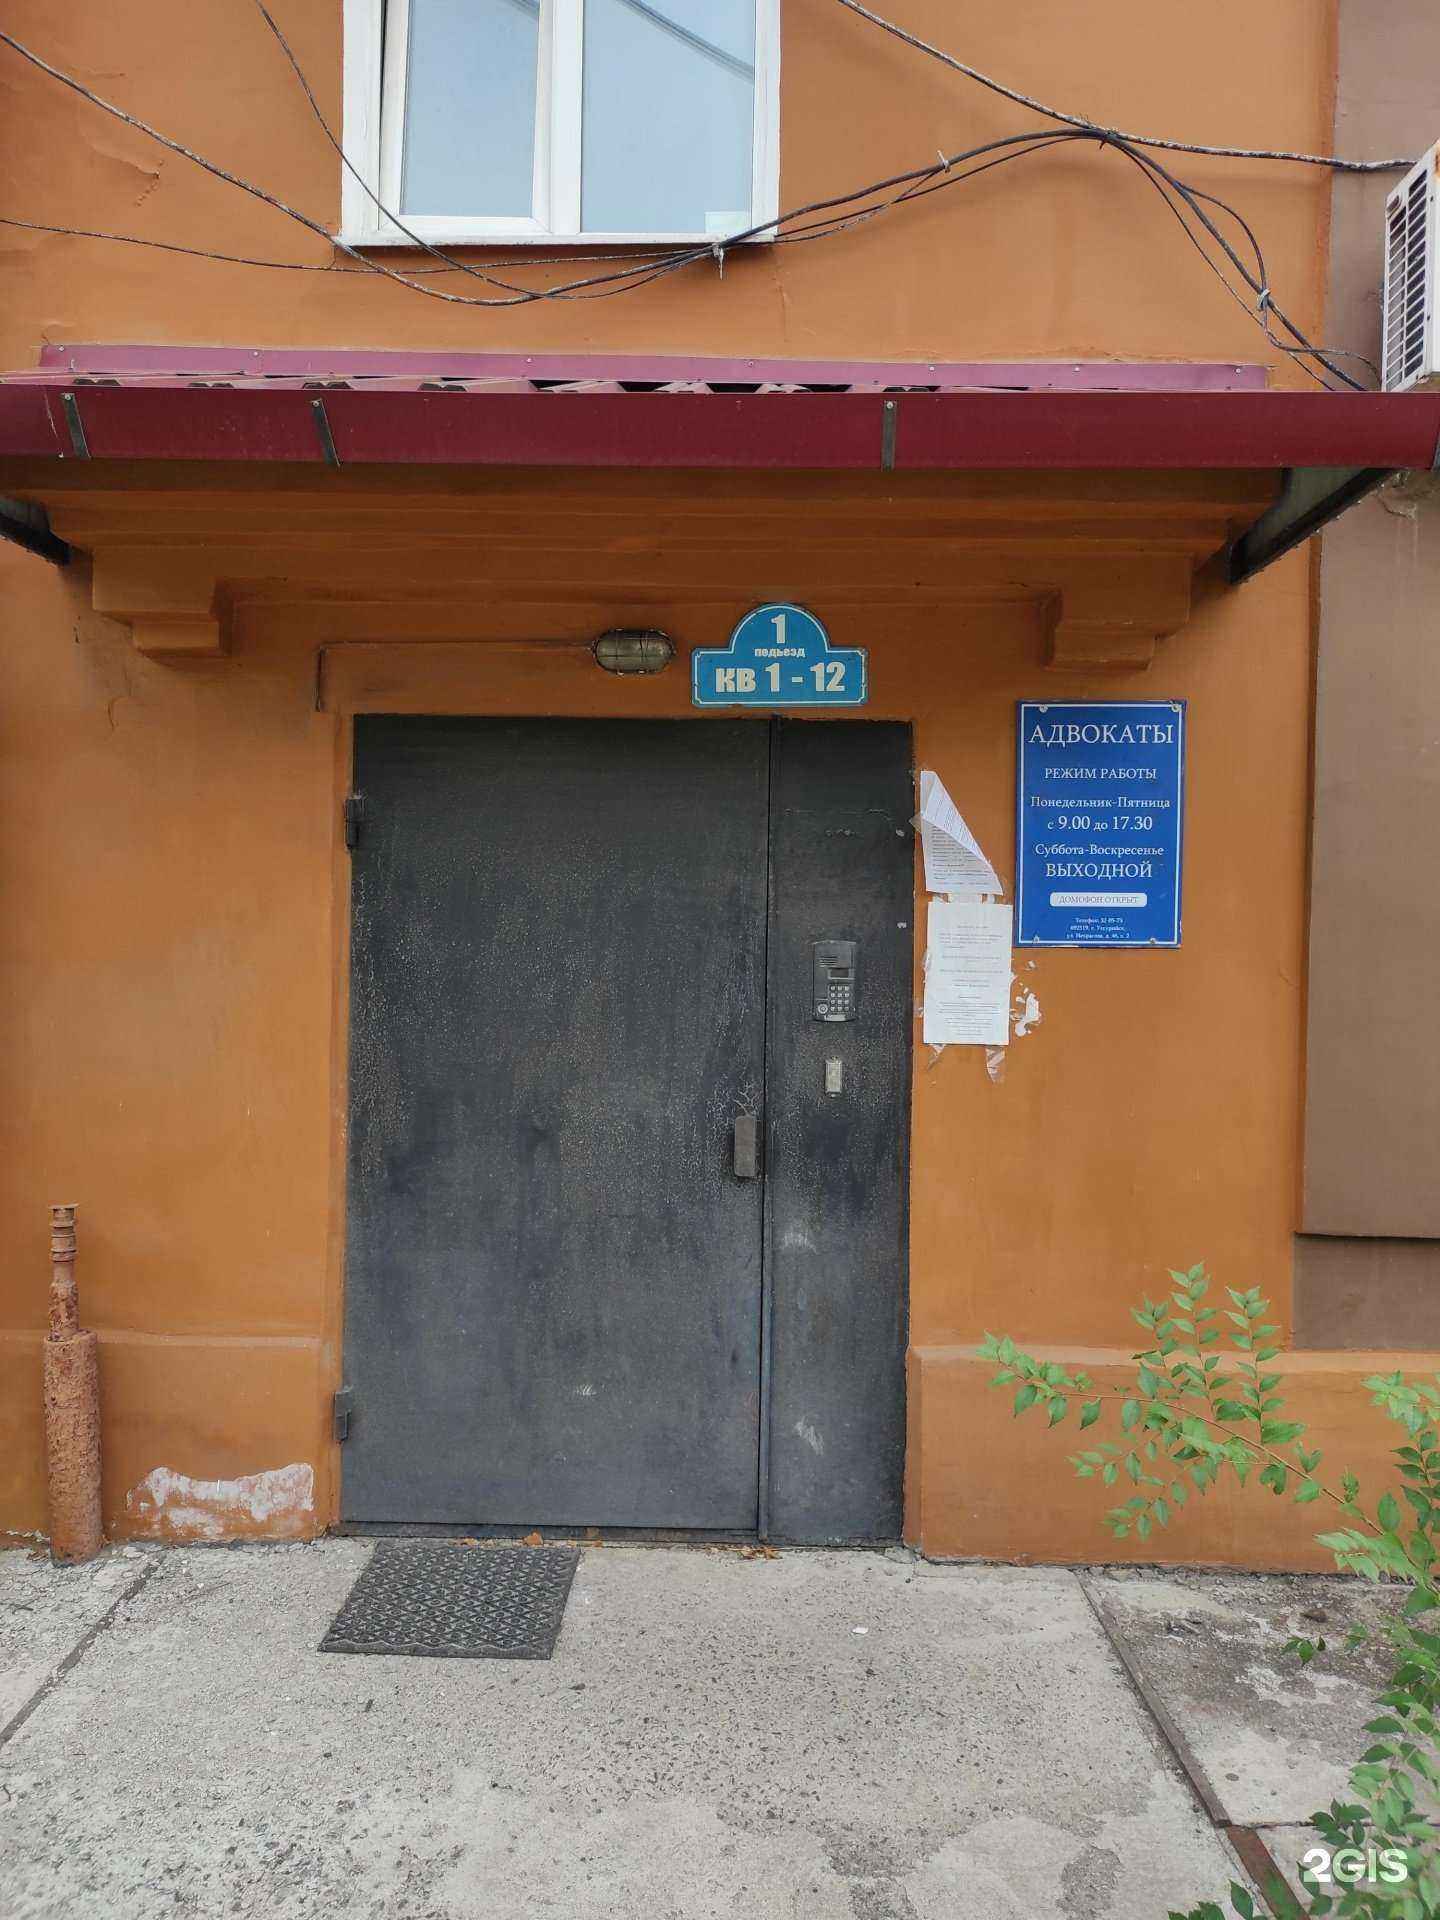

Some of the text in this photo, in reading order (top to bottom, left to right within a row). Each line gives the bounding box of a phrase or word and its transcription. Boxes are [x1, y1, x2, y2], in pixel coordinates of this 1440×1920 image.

[770, 613, 786, 644] 1
[764, 662, 781, 692] 1
[809, 661, 846, 692] 12
[1028, 724, 1175, 748] АДВОКАТЫ
[1044, 768, 1157, 780] РЕЖИМ РАБОТЫ
[1047, 815, 1153, 832] с 9.00 до 17.30
[1045, 860, 1153, 881] ВЫХОДНОЙ
[1058, 895, 1137, 905] ДОМОФОН ОТКРЫТ
